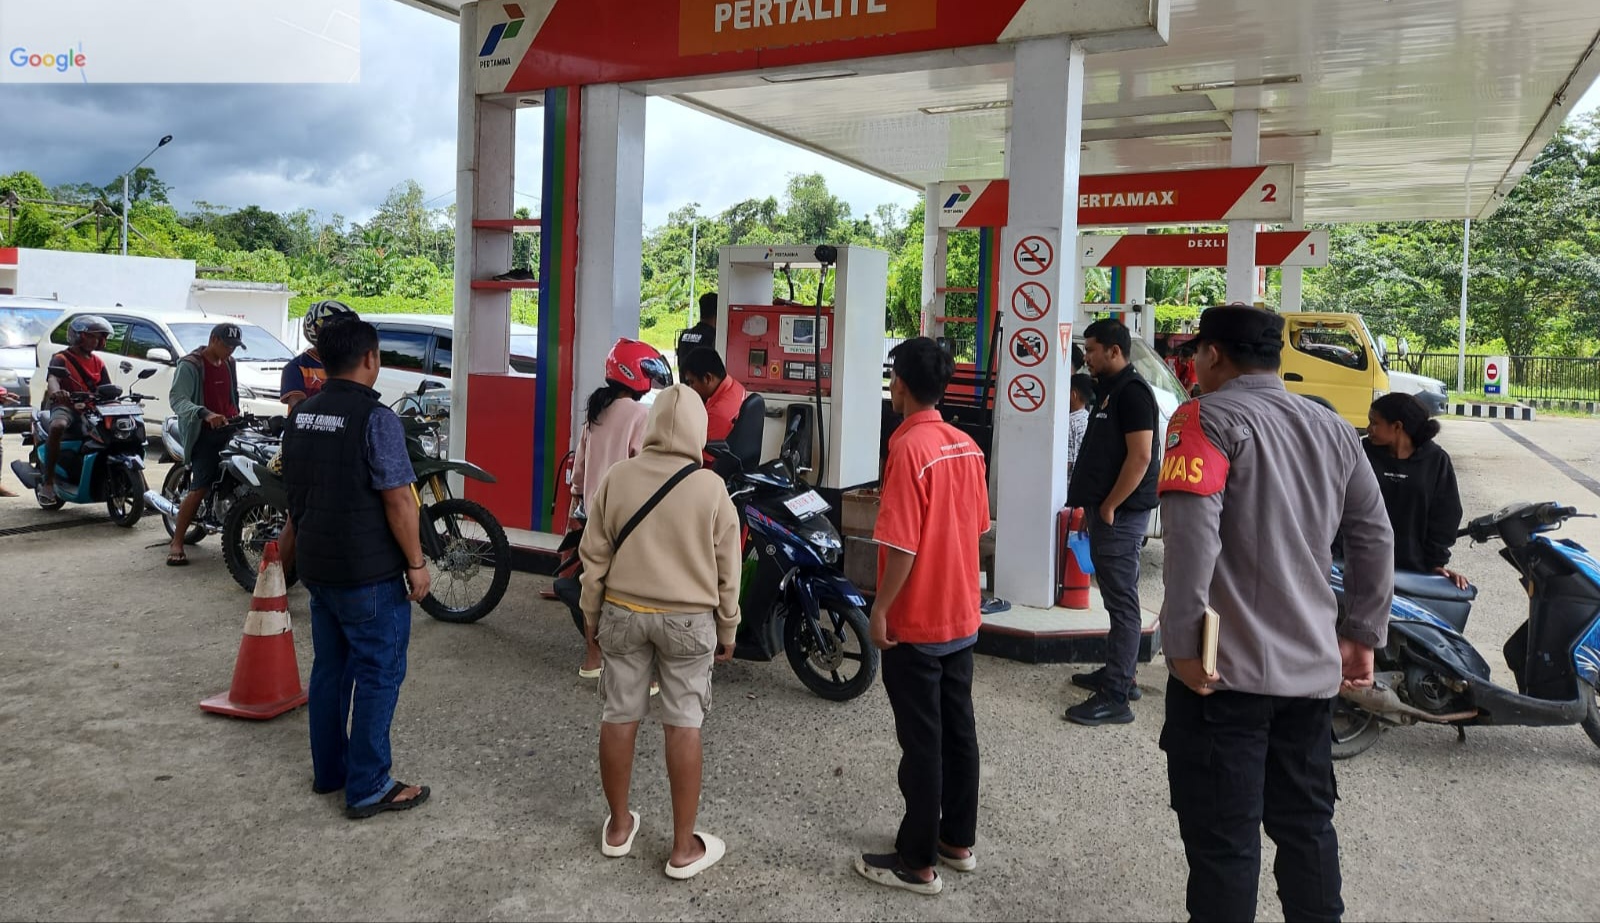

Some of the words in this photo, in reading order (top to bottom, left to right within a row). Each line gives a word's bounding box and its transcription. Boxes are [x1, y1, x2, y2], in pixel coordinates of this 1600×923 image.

[480, 57, 511, 68] PERTAMINA
[1260, 183, 1277, 203] 2
[1079, 191, 1174, 208] ERTAMAX
[1188, 239, 1225, 248] DEXLI
[1308, 243, 1315, 256] 1
[228, 327, 238, 338] N
